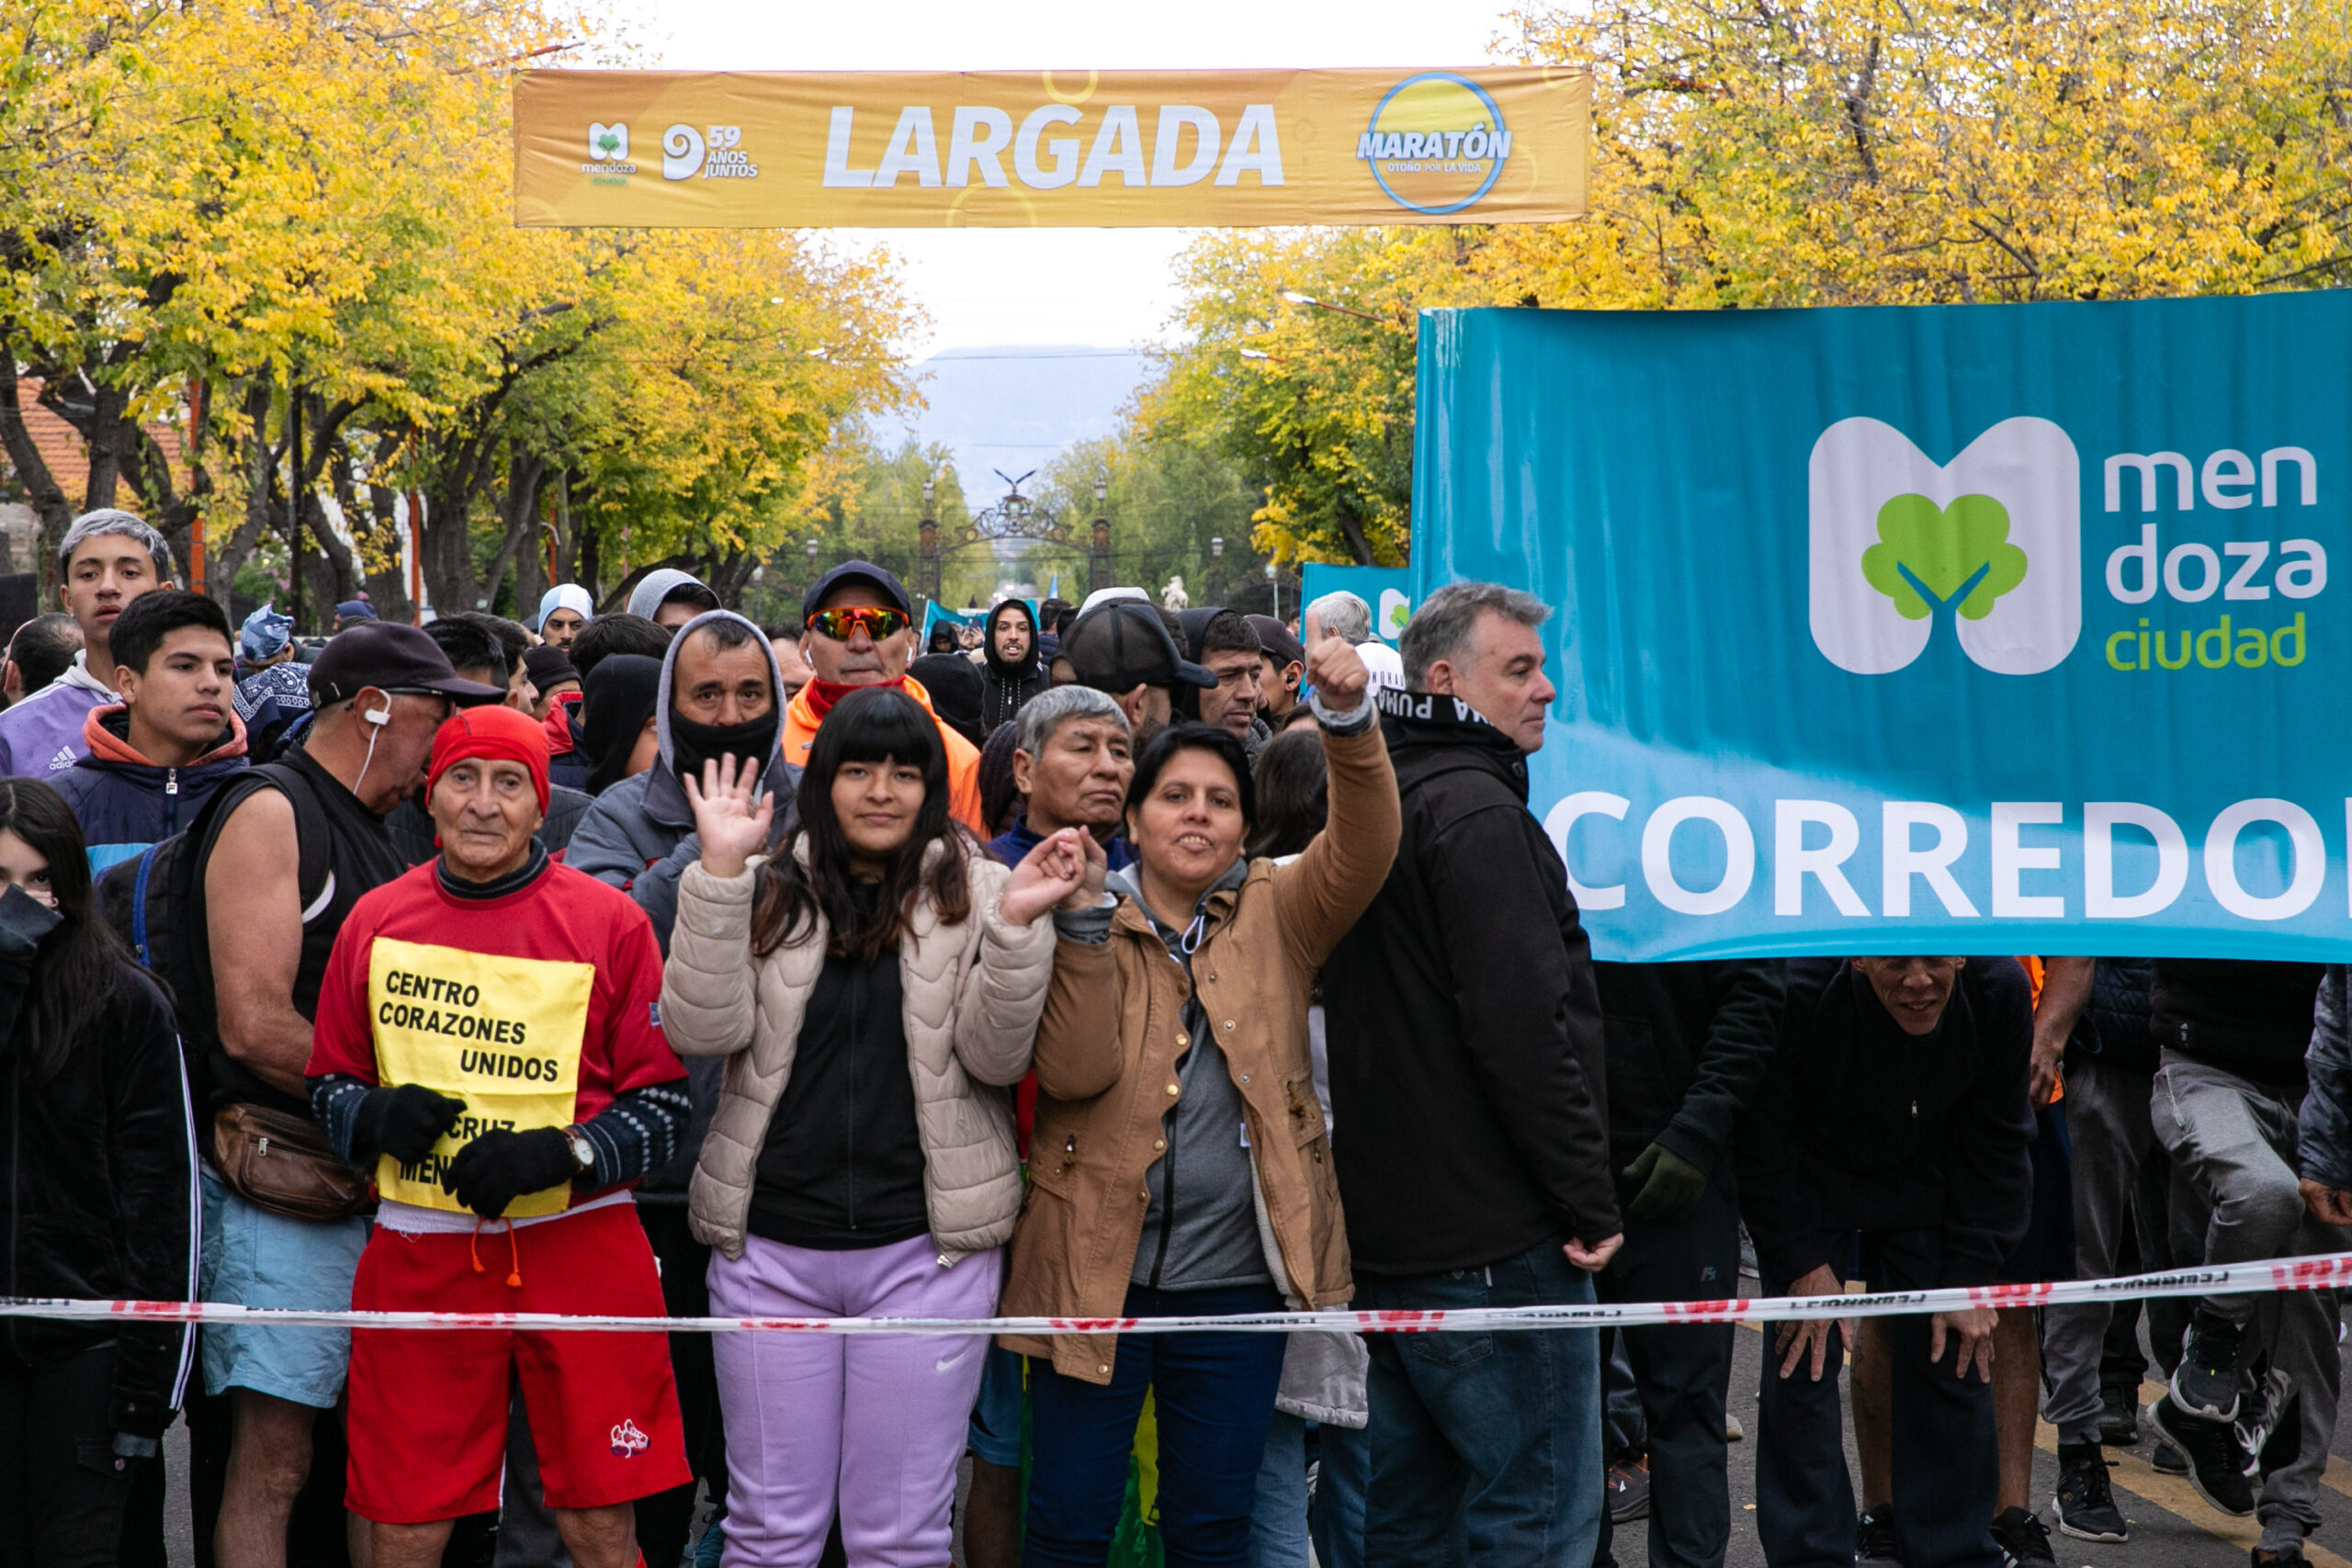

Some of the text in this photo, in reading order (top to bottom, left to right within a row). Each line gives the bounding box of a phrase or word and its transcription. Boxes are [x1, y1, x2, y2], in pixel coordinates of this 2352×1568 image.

[707, 126, 742, 149] 59
[822, 104, 1285, 189] LARGADA
[1357, 121, 1512, 159] MARATÓN
[582, 162, 637, 174] mendoza
[703, 164, 759, 179] JUNTOS
[707, 148, 748, 164] AÑOS
[1387, 161, 1421, 173] OTOÑO
[1443, 163, 1456, 173] LA
[1457, 163, 1481, 173] VIDA
[2104, 446, 2317, 513] men
[2105, 523, 2327, 604] doza
[2106, 612, 2306, 671] ciudad
[1378, 689, 1433, 719] PUMA
[1543, 790, 2352, 920] CORREDO
[386, 971, 480, 1007] CENTRO
[379, 1002, 526, 1045] CORAZONES
[460, 1049, 559, 1082] UNIDOS
[399, 1153, 456, 1186] MEN
